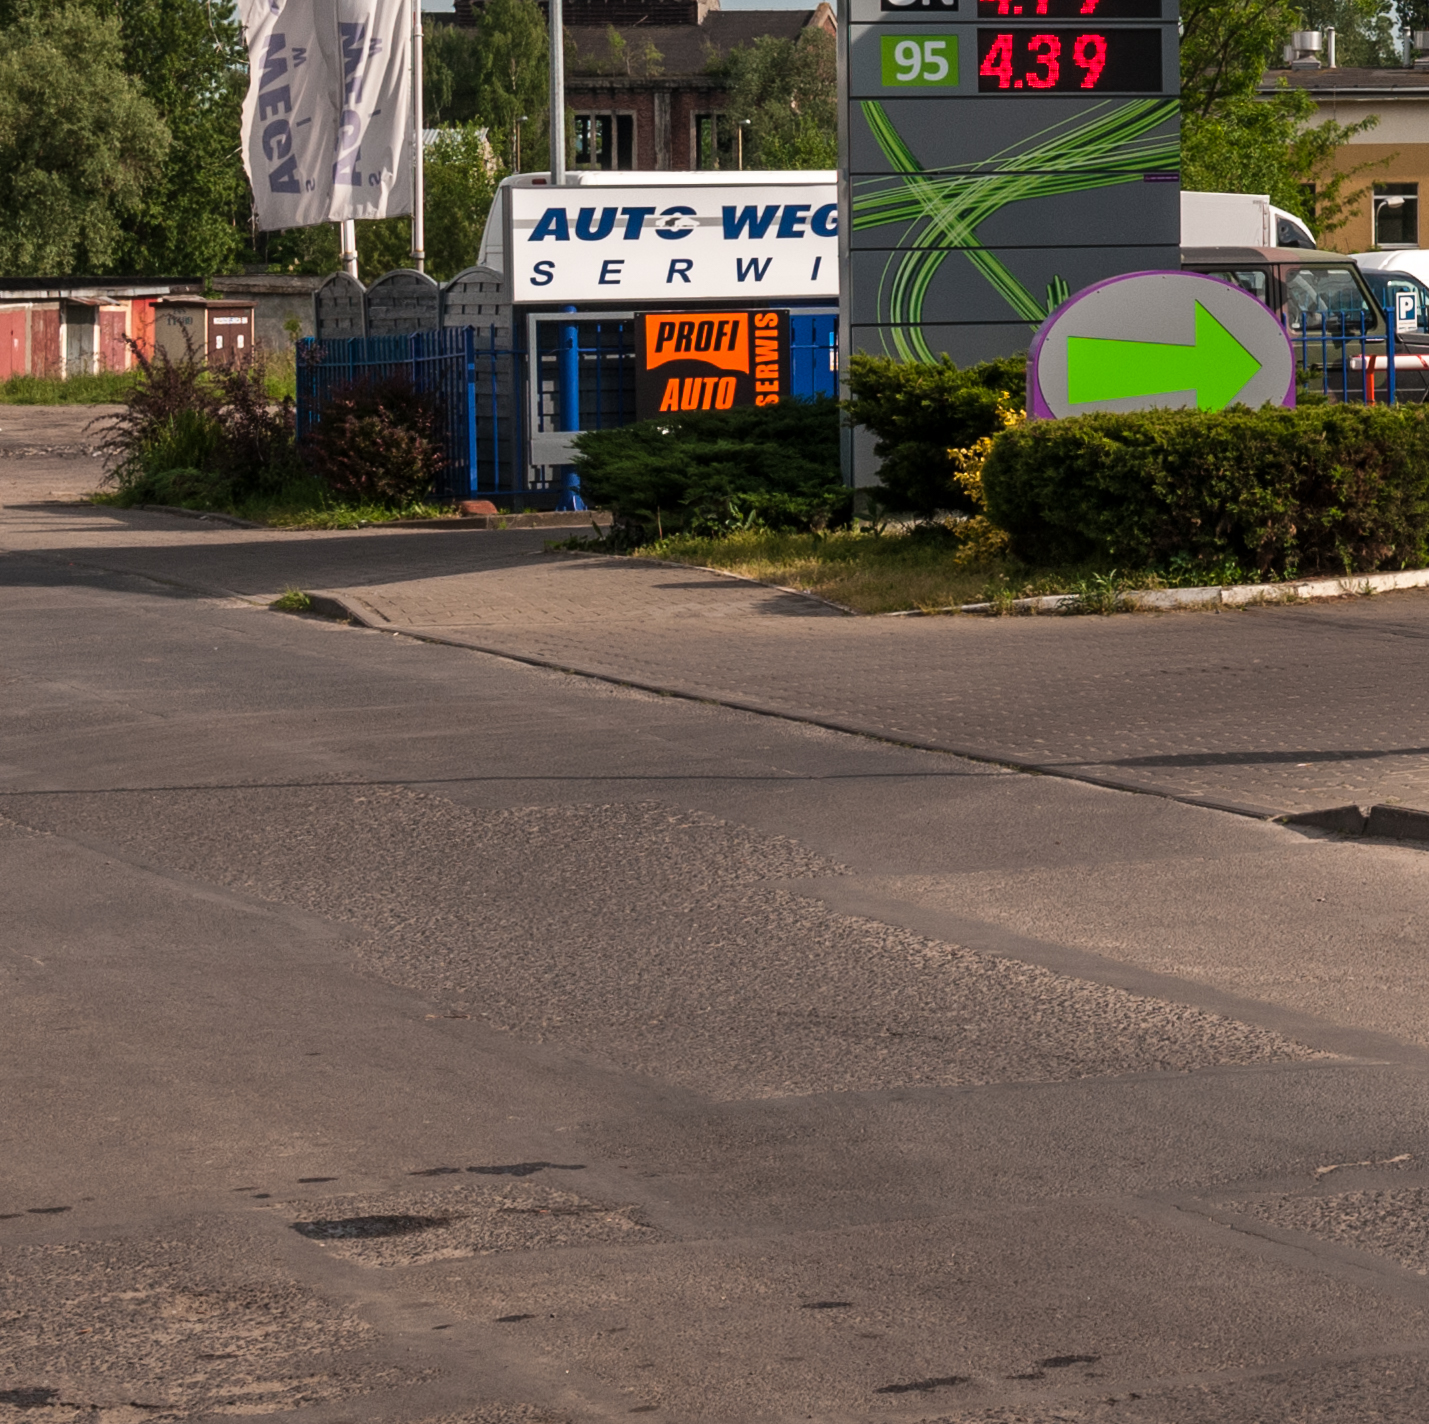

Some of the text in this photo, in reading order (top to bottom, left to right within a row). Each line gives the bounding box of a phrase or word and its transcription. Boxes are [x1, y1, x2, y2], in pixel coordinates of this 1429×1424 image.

[894, 33, 1108, 89] 95 4.39
[527, 203, 838, 242] AUTO WEG
[529, 256, 822, 286] SERWI
[1400, 296, 1414, 319] P
[654, 320, 740, 412] PROFI AUTO
[754, 312, 780, 407] SERWIS
